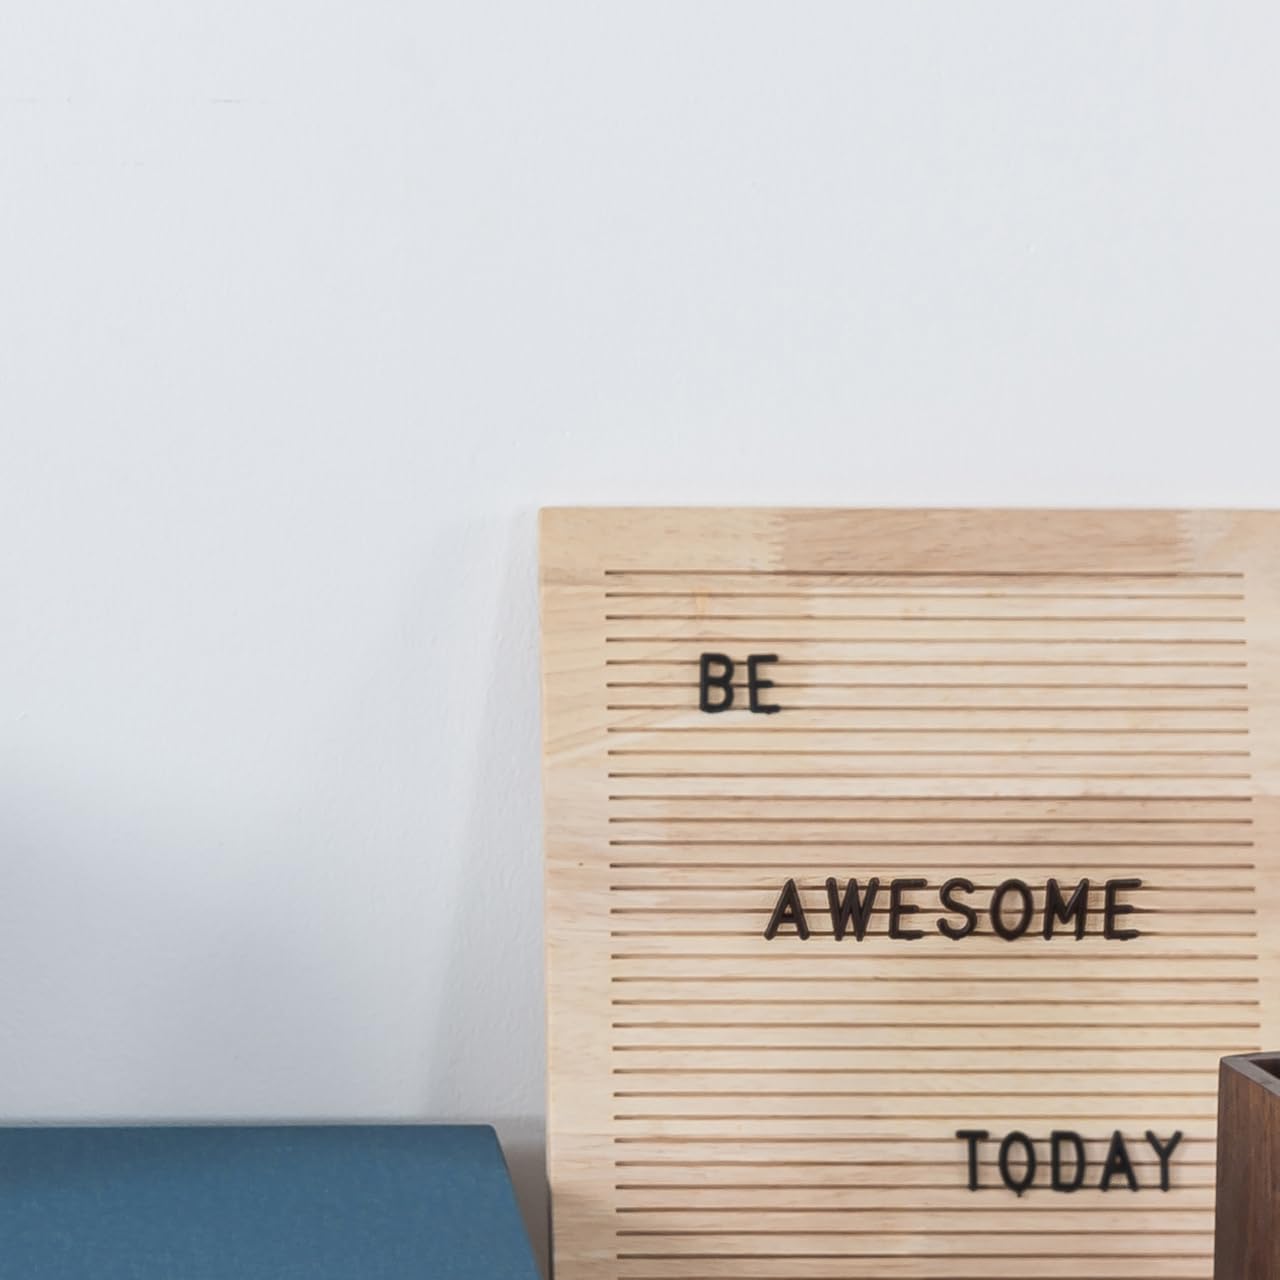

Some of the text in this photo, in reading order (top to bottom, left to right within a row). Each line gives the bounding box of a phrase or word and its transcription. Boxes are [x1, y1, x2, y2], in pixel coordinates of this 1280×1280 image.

[699, 653, 781, 714] BE
[764, 877, 1142, 941] AWESOME
[956, 1130, 1182, 1197] TODAY
